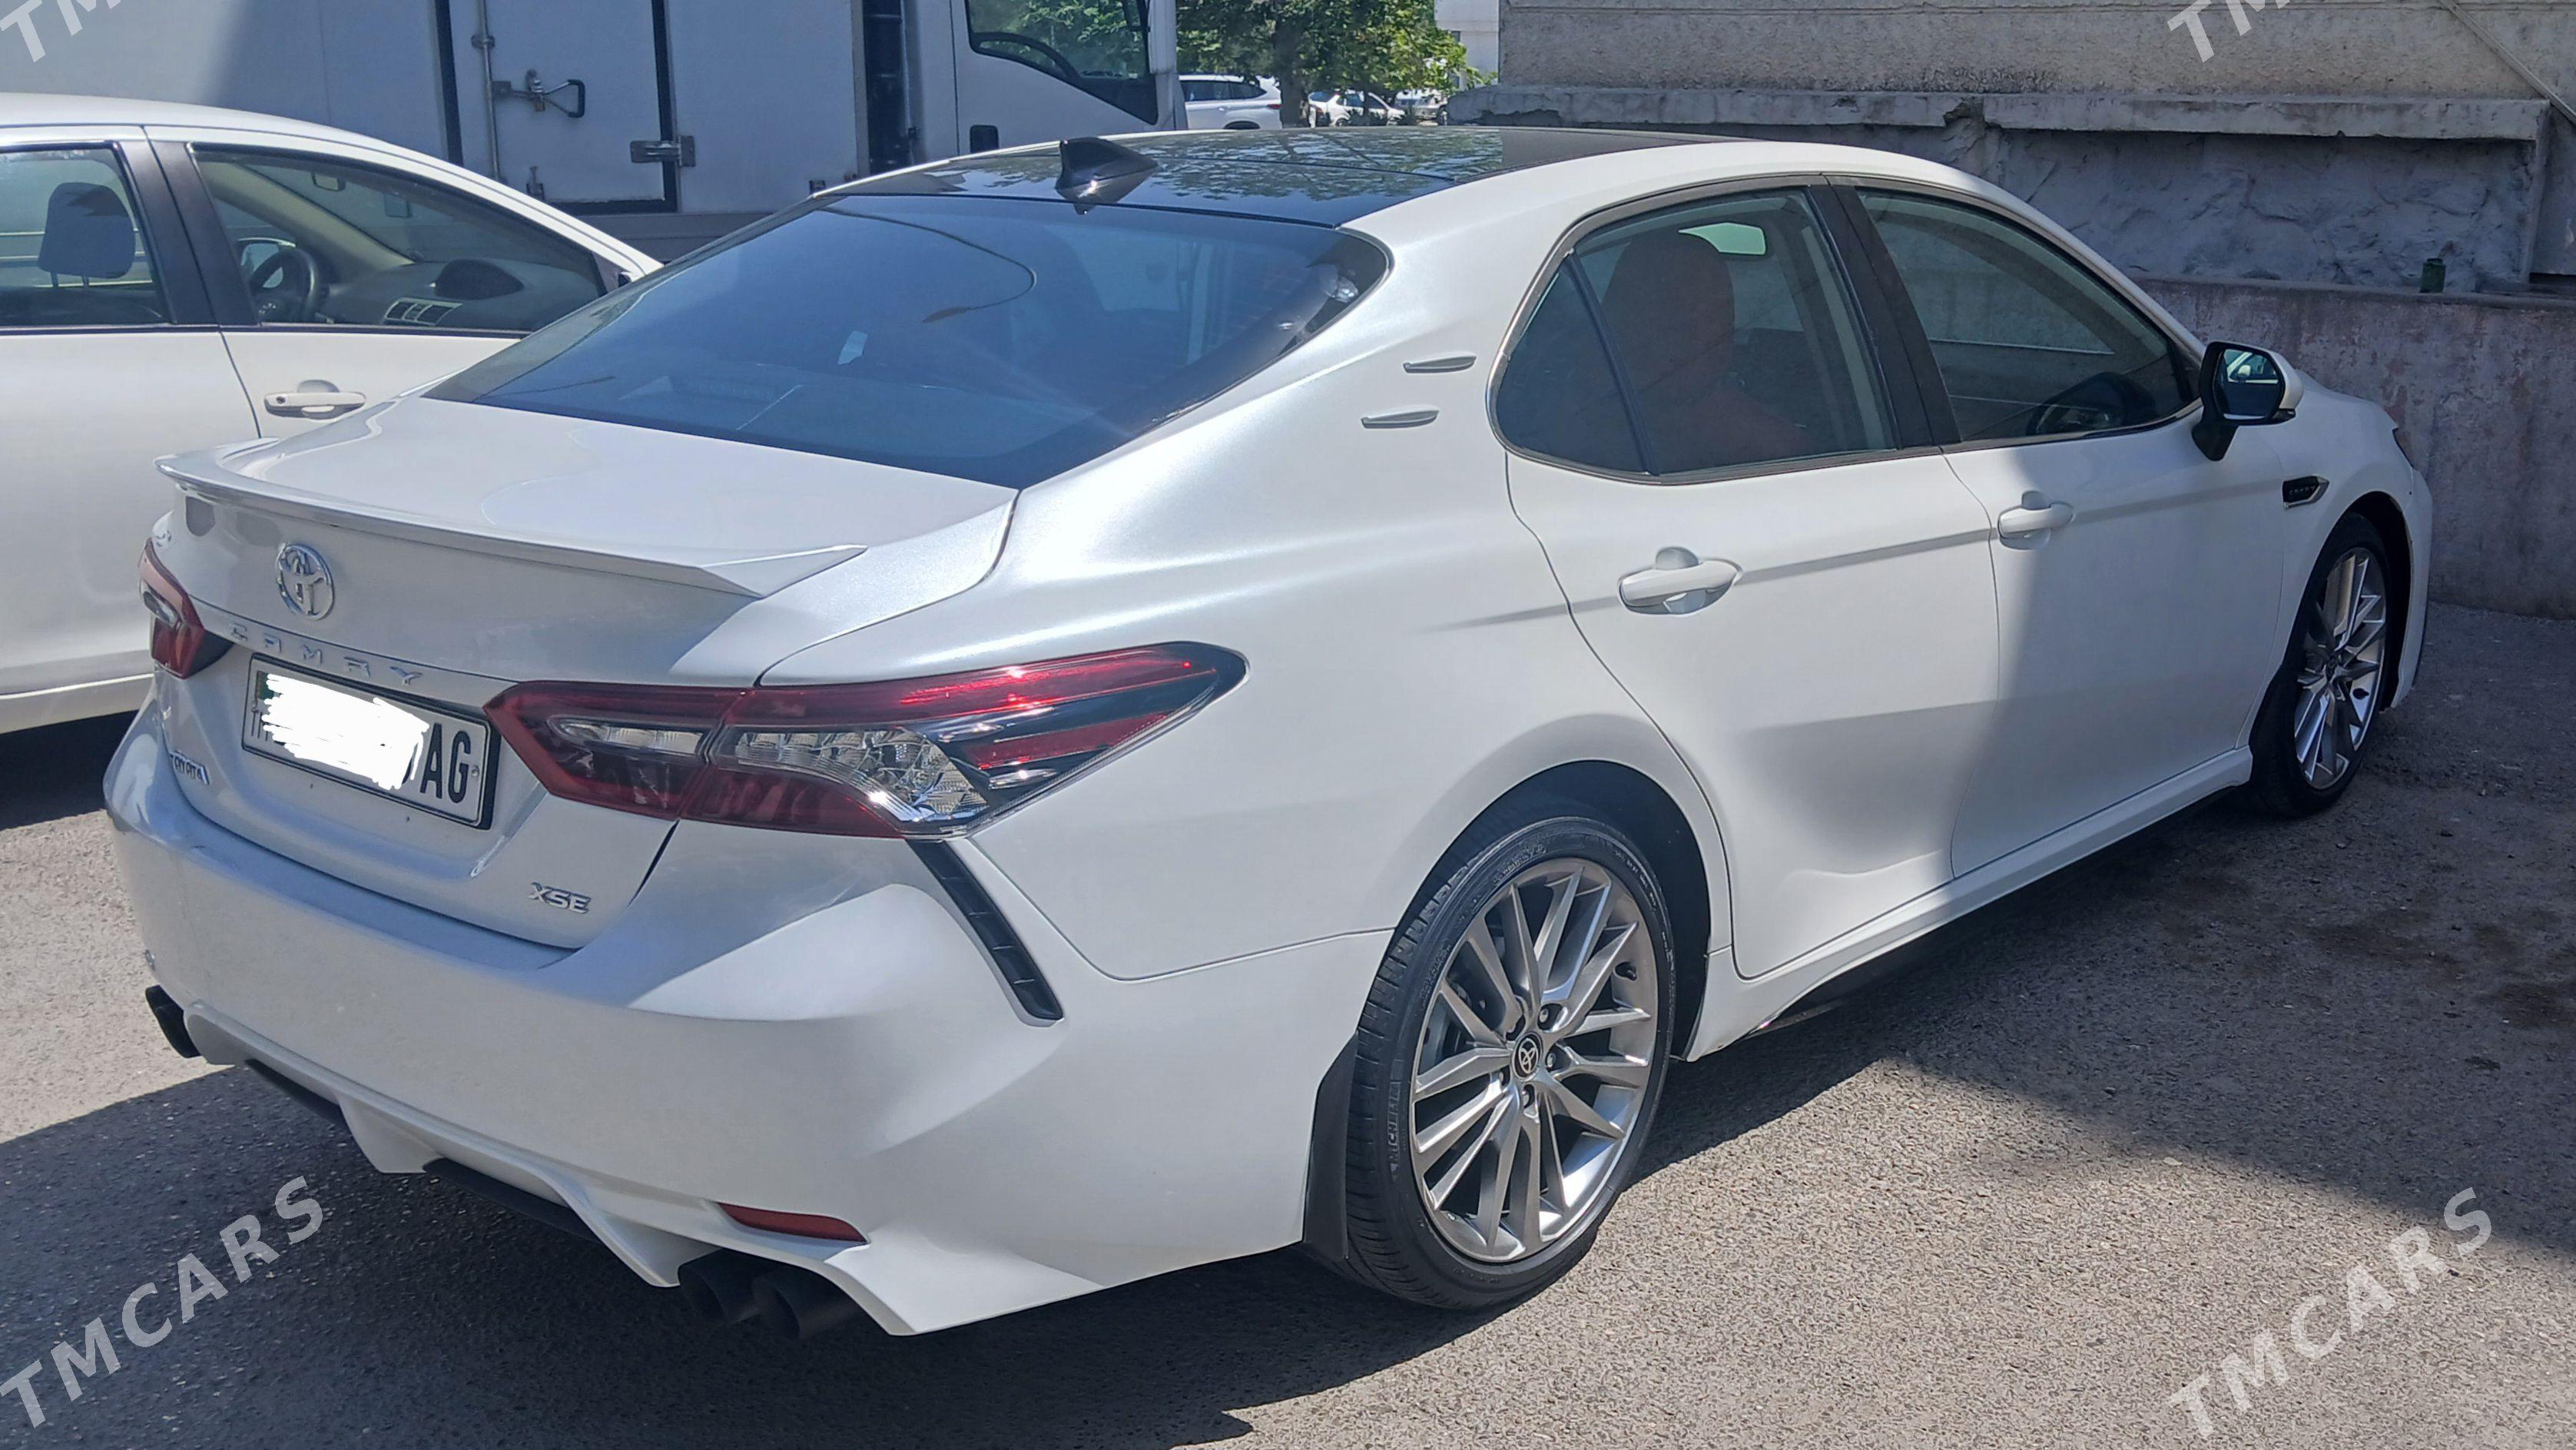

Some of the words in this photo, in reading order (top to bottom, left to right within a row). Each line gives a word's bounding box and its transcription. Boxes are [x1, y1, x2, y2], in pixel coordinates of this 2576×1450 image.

[230, 622, 423, 685] CAMRY
[419, 722, 472, 805] AG
[529, 881, 592, 914] XSE
